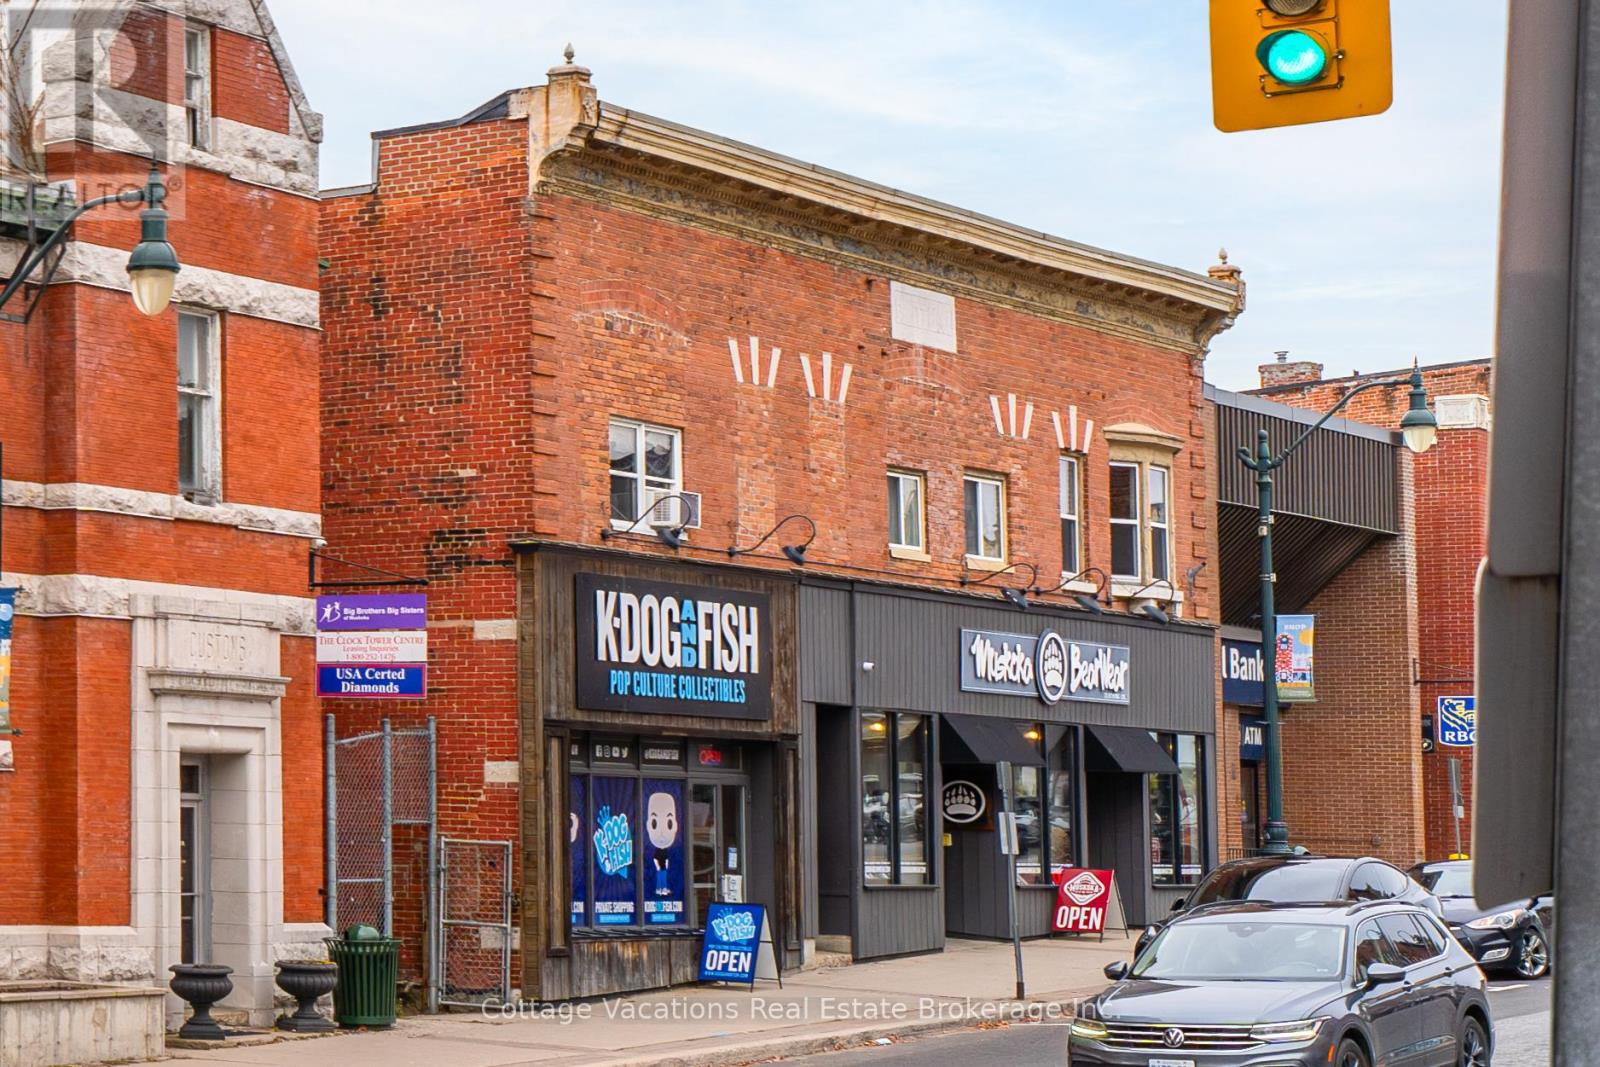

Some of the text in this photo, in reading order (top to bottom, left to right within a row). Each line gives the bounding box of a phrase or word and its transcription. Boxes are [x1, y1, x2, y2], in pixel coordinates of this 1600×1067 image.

[343, 606, 424, 616] Big Brothers Big Sisters
[319, 636, 424, 645] THE CLOCK TOWER CENTRE
[595, 589, 760, 674] K-DOG AND FISH
[342, 645, 368, 653] Leasing
[970, 634, 1034, 685] Muskoka
[1229, 647, 1265, 682] Bank
[336, 668, 406, 680] USA Certed
[341, 681, 400, 694] Diamonds
[609, 669, 746, 704] POP CULTURE COLLECTIBLES
[1244, 726, 1263, 746] ATM
[1056, 905, 1103, 930] OPEN
[728, 925, 756, 942] FISH
[705, 949, 752, 973] OPEN
